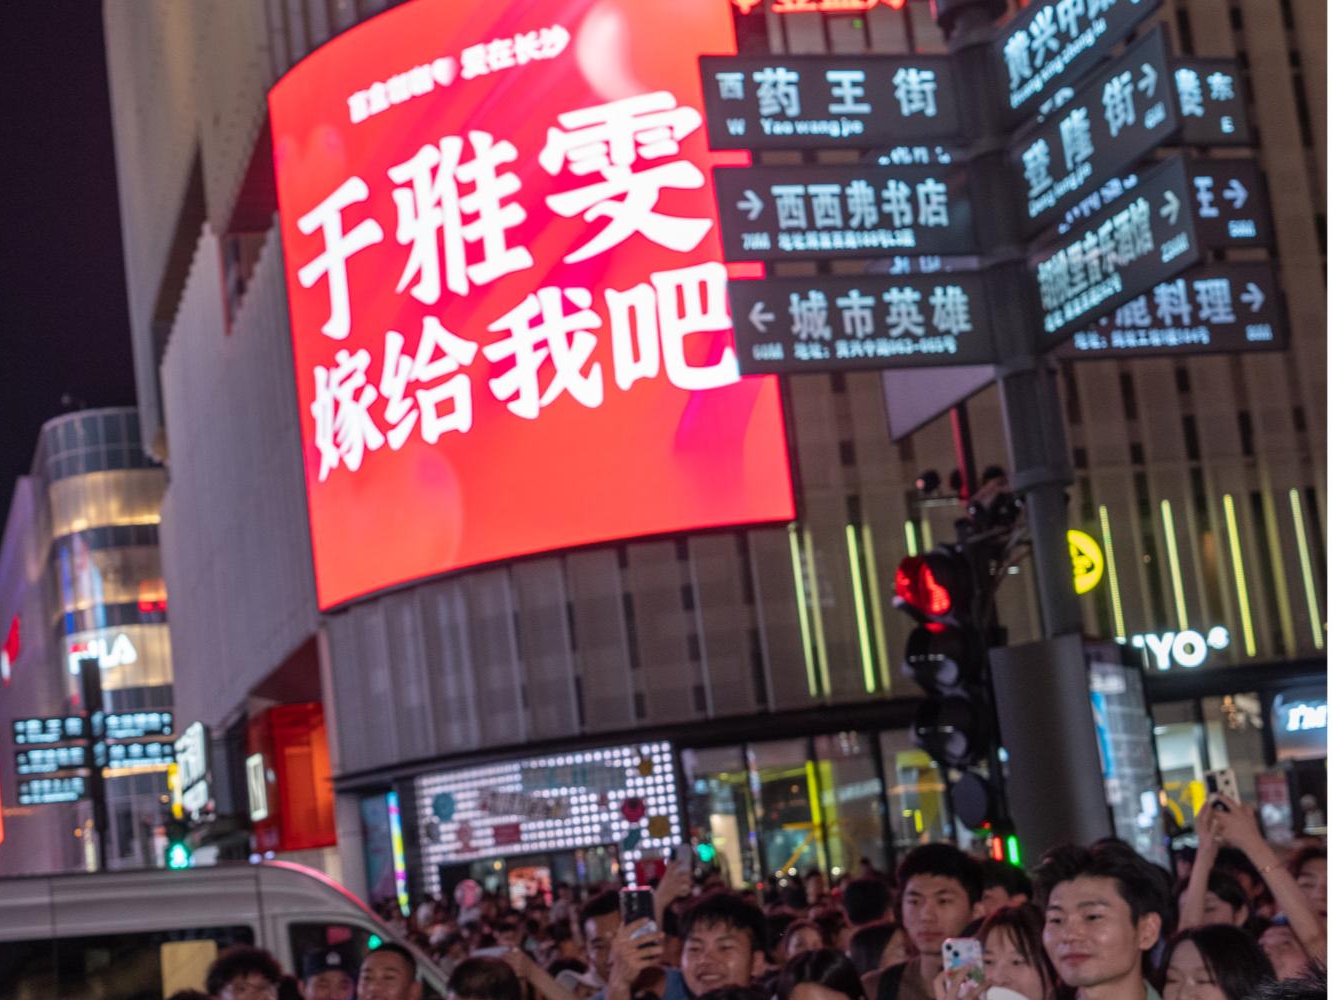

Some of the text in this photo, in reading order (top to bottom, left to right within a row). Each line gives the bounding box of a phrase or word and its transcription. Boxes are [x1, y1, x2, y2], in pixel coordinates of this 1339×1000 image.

[716, 67, 937, 118] 西 药王街
[1022, 70, 1136, 199] 登隆街
[771, 178, 949, 229] 西西弗书店
[789, 286, 972, 340] 城市英雄
[311, 261, 740, 482] 嫁给我吧
